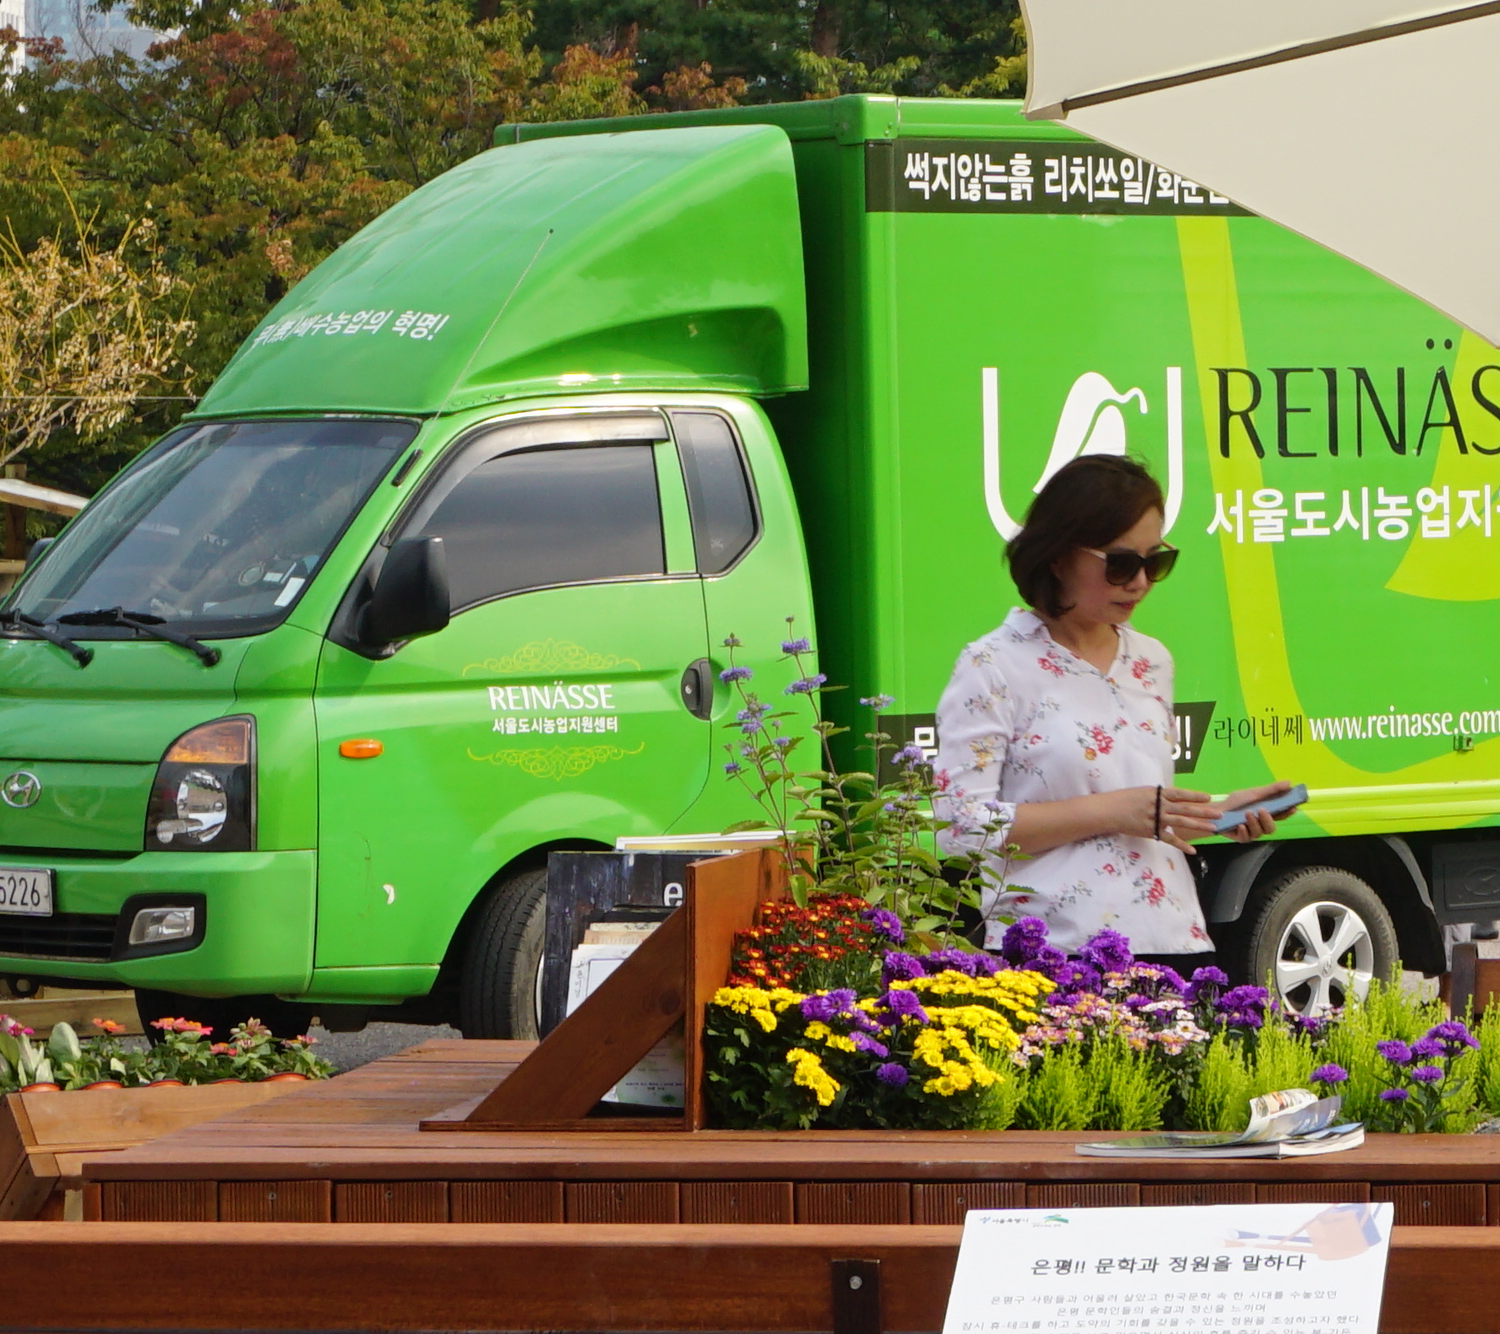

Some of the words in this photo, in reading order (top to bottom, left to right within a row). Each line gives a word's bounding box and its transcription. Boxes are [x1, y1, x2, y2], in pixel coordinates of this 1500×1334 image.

[904, 153, 1034, 202] 썩지않는흙
[1045, 155, 1230, 206] 리치쏘일/화
[392, 310, 450, 341] 혁명!
[486, 680, 616, 711] REINÄSSE
[492, 715, 618, 735] 서울도시농업지원센터
[1031, 1258, 1087, 1276] 은평!!
[1095, 1256, 1160, 1274] 문학과
[1168, 1255, 1232, 1273] 정원을
[1242, 1254, 1307, 1272] 말하다
[1031, 1294, 1078, 1305] 사람들과
[1164, 1292, 1211, 1302] 한국문학
[1233, 1291, 1244, 1300] 한
[1047, 1320, 1070, 1329] 하고
[1185, 1317, 1196, 1327] 수
[1202, 1317, 1225, 1327] 있는
[1231, 1316, 1265, 1326] 정원을
